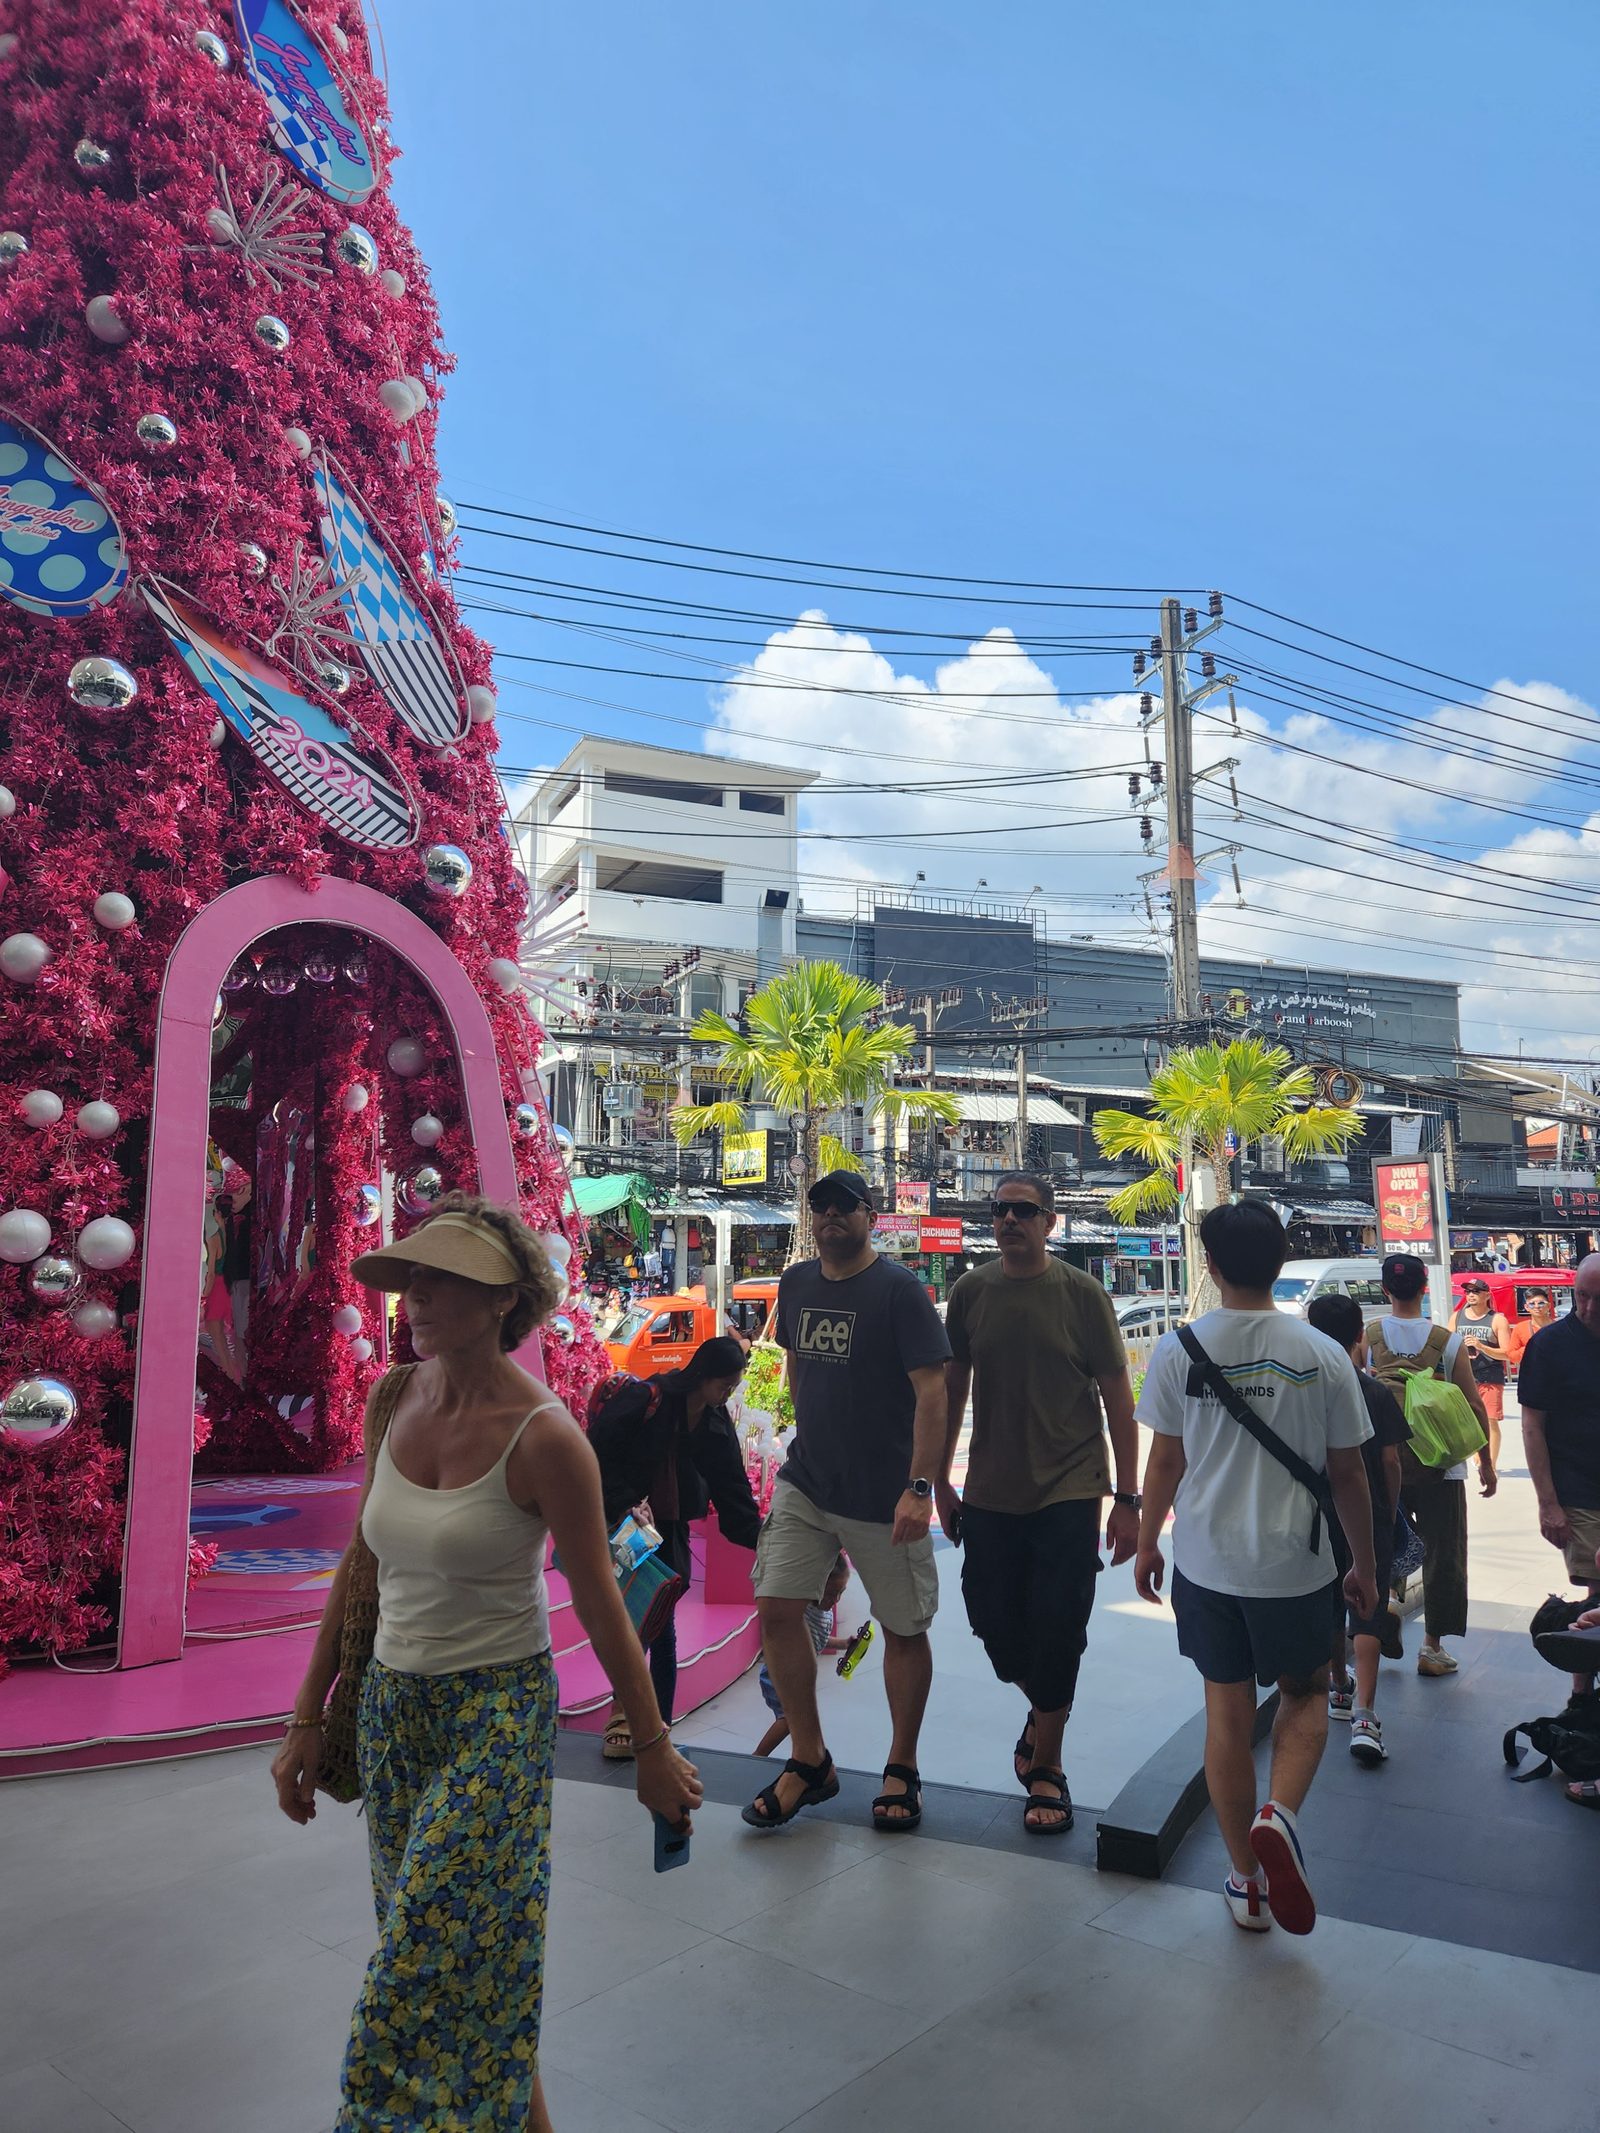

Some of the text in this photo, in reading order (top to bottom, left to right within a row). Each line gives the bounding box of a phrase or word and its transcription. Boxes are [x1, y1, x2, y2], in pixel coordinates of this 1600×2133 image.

[253, 33, 365, 166] Jungceylon
[0, 486, 96, 533] ungceylon
[267, 716, 374, 809] 2024
[1274, 1012, 1353, 1028] Grand Tarboosh
[1392, 1167, 1417, 1179] NOW
[1390, 1179, 1419, 1191] OPEN
[921, 1228, 960, 1238] EXCHANGE
[1152, 1242, 1181, 1252] EXCANG
[800, 1312, 849, 1353] Lee
